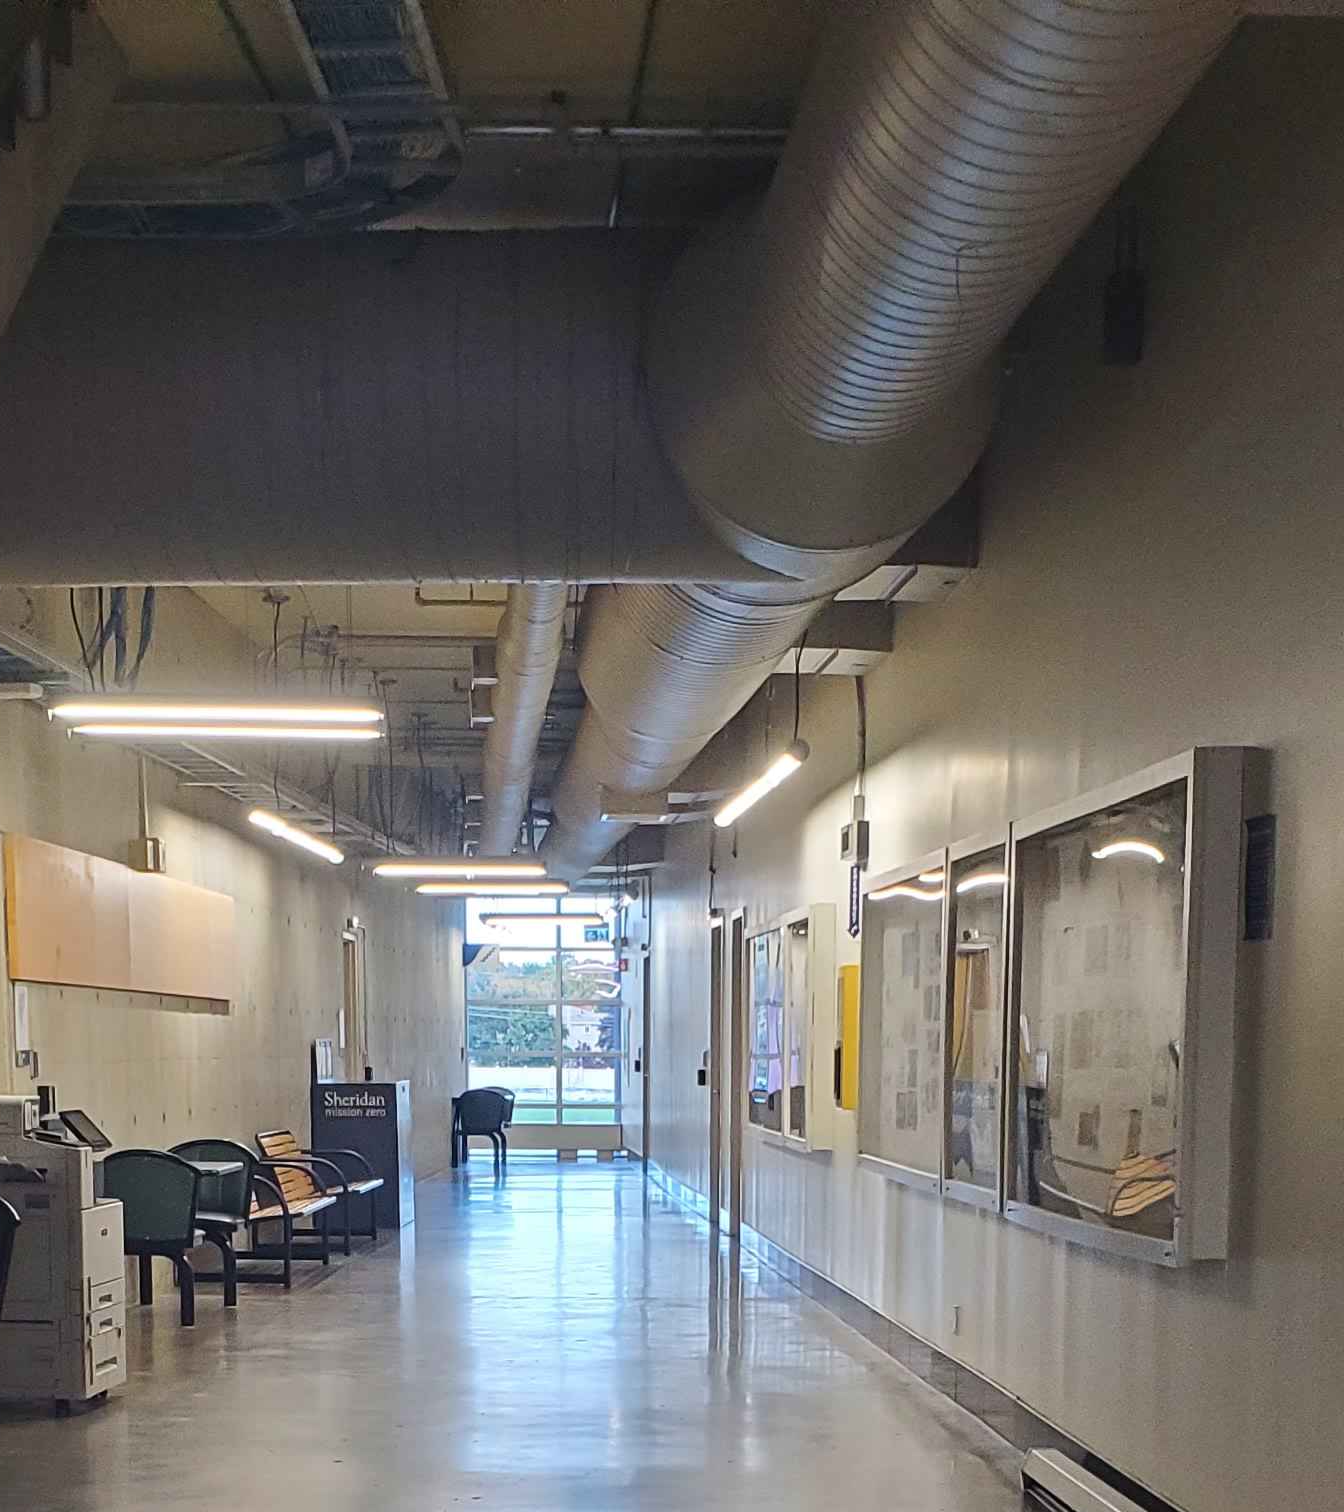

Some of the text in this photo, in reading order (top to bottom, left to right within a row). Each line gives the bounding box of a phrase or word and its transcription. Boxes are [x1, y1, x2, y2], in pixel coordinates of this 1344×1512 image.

[324, 1091, 385, 1107] Sheridan
[325, 1107, 386, 1117] mission zero
